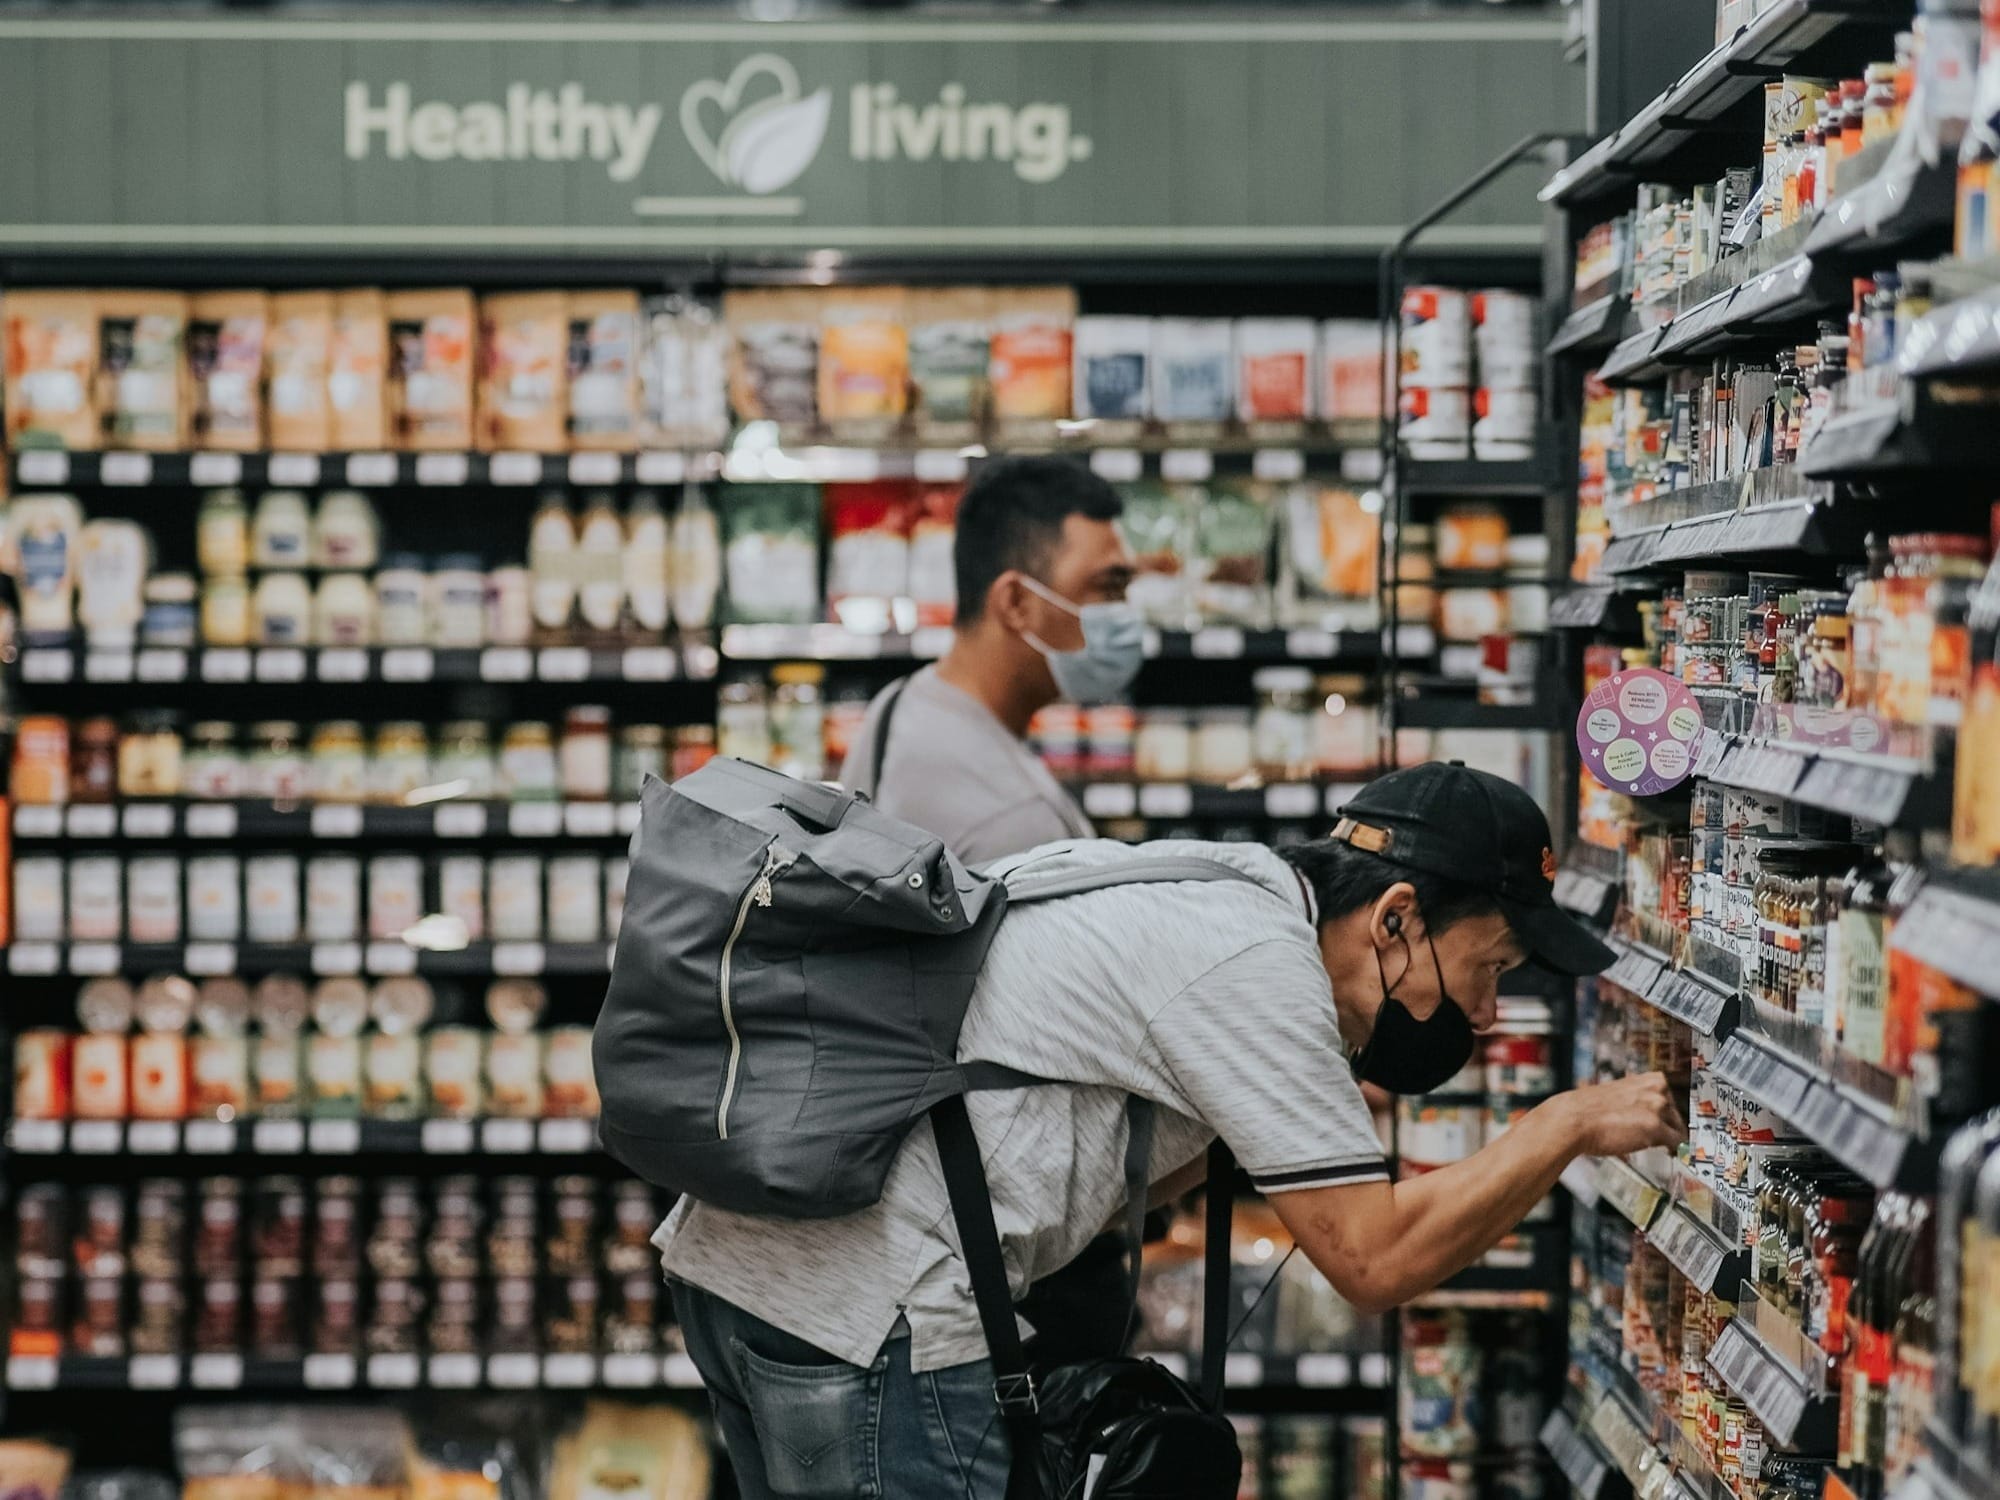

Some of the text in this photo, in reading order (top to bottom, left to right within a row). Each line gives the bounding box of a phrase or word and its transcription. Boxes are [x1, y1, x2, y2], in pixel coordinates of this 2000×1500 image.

[345, 81, 1094, 183] Healthy living.
[1738, 363, 1762, 371] Tuna
